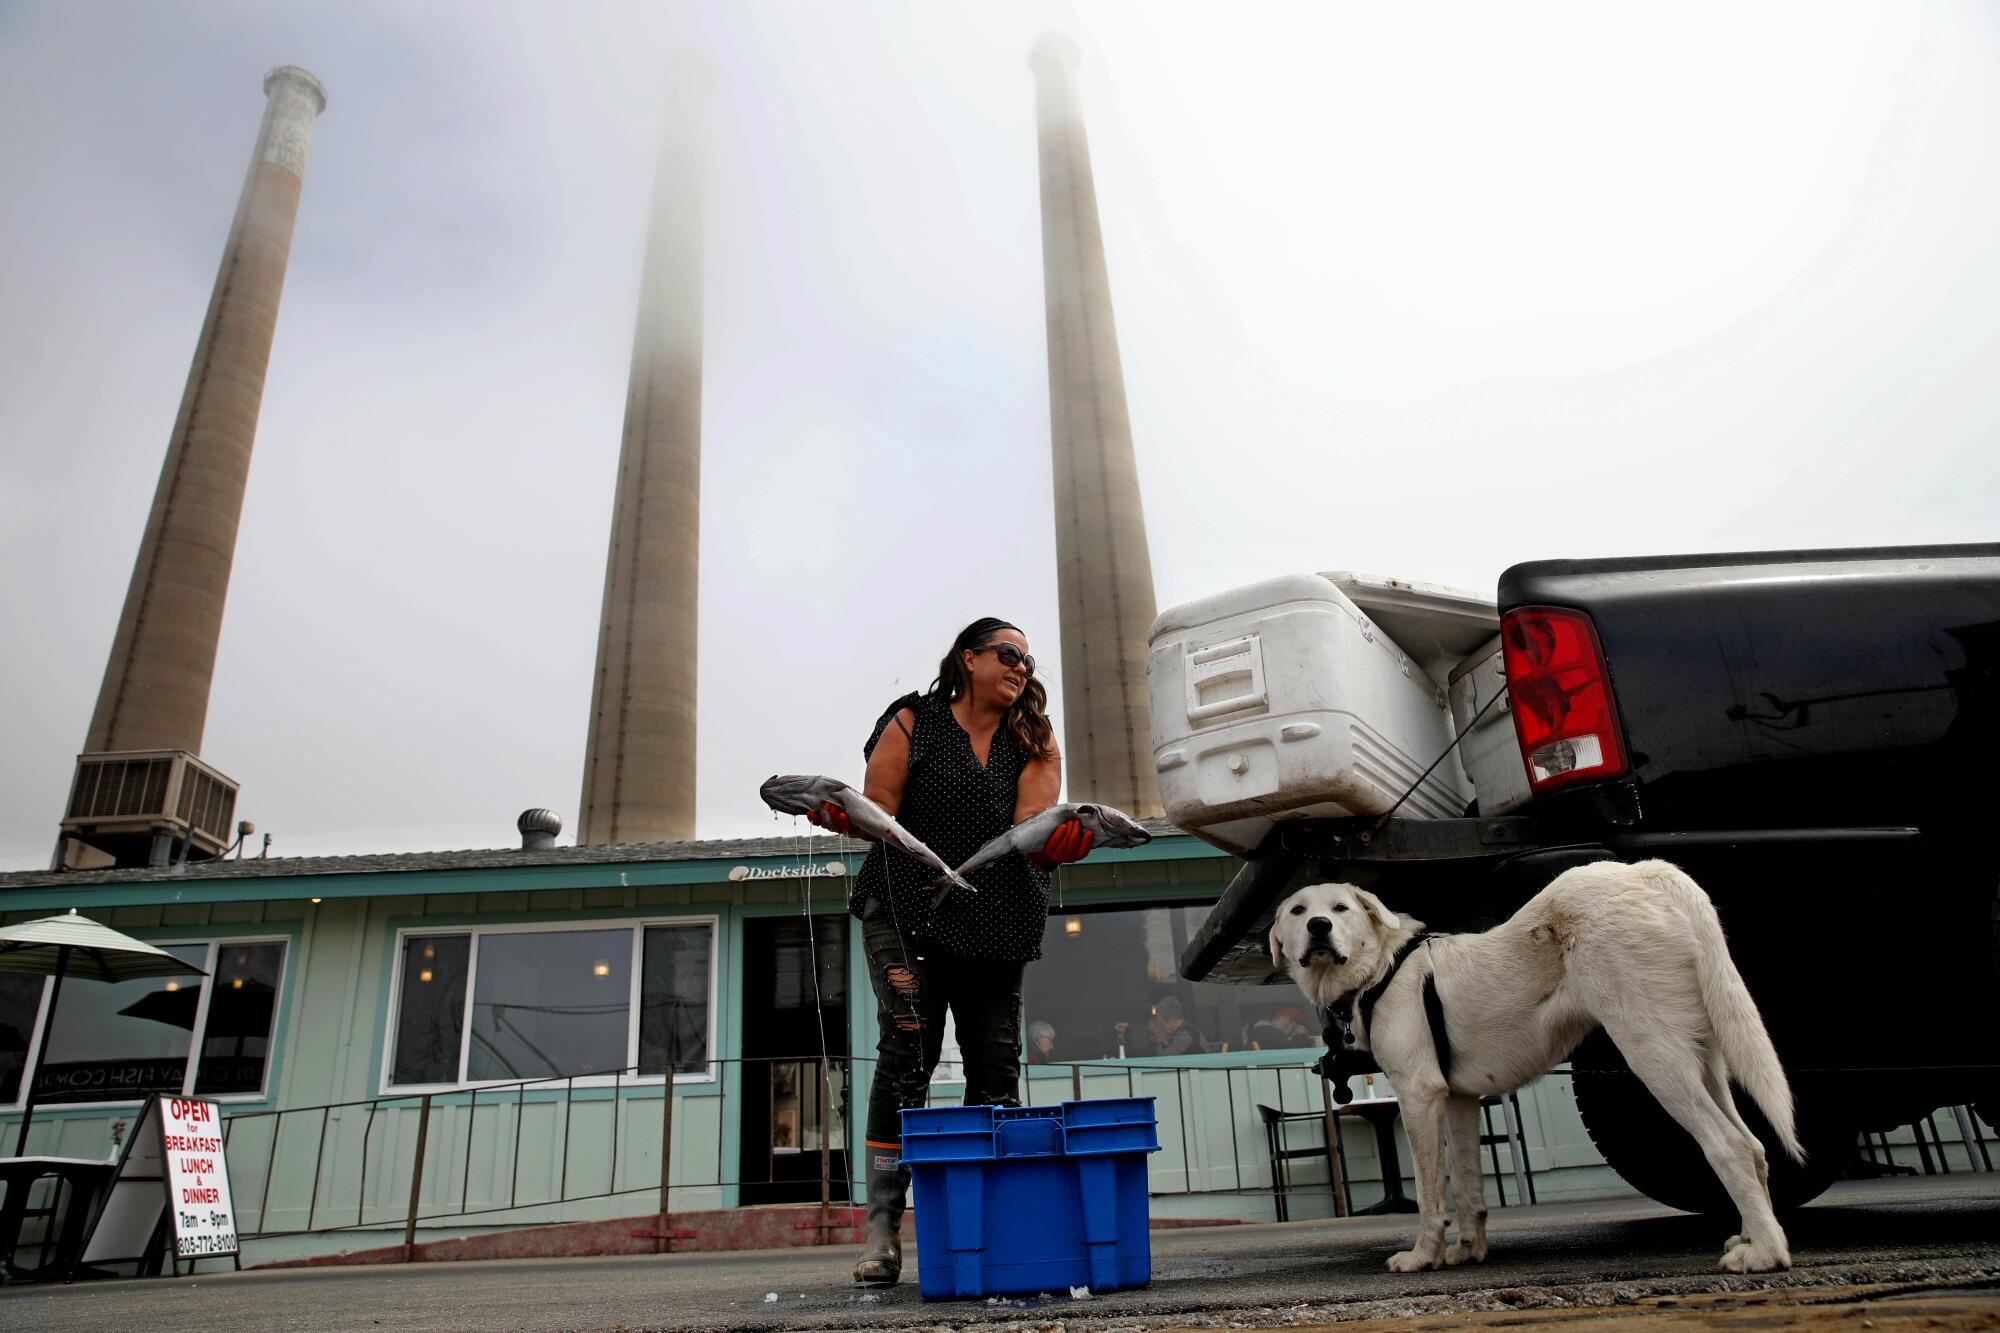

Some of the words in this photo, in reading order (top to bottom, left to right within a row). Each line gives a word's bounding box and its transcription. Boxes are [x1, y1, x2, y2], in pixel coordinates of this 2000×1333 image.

[749, 864, 826, 878] Dockside
[171, 1098, 210, 1122] OPEN
[187, 1122, 198, 1133] for
[164, 1135, 221, 1153] BREAKFAST
[181, 1158, 214, 1174] LUNCH
[196, 1176, 203, 1186] &
[183, 1188, 220, 1204] DINNER
[179, 1211, 199, 1228] 7am
[210, 1210, 229, 1230] 9pm
[178, 1233, 237, 1255] 805-772-8100
